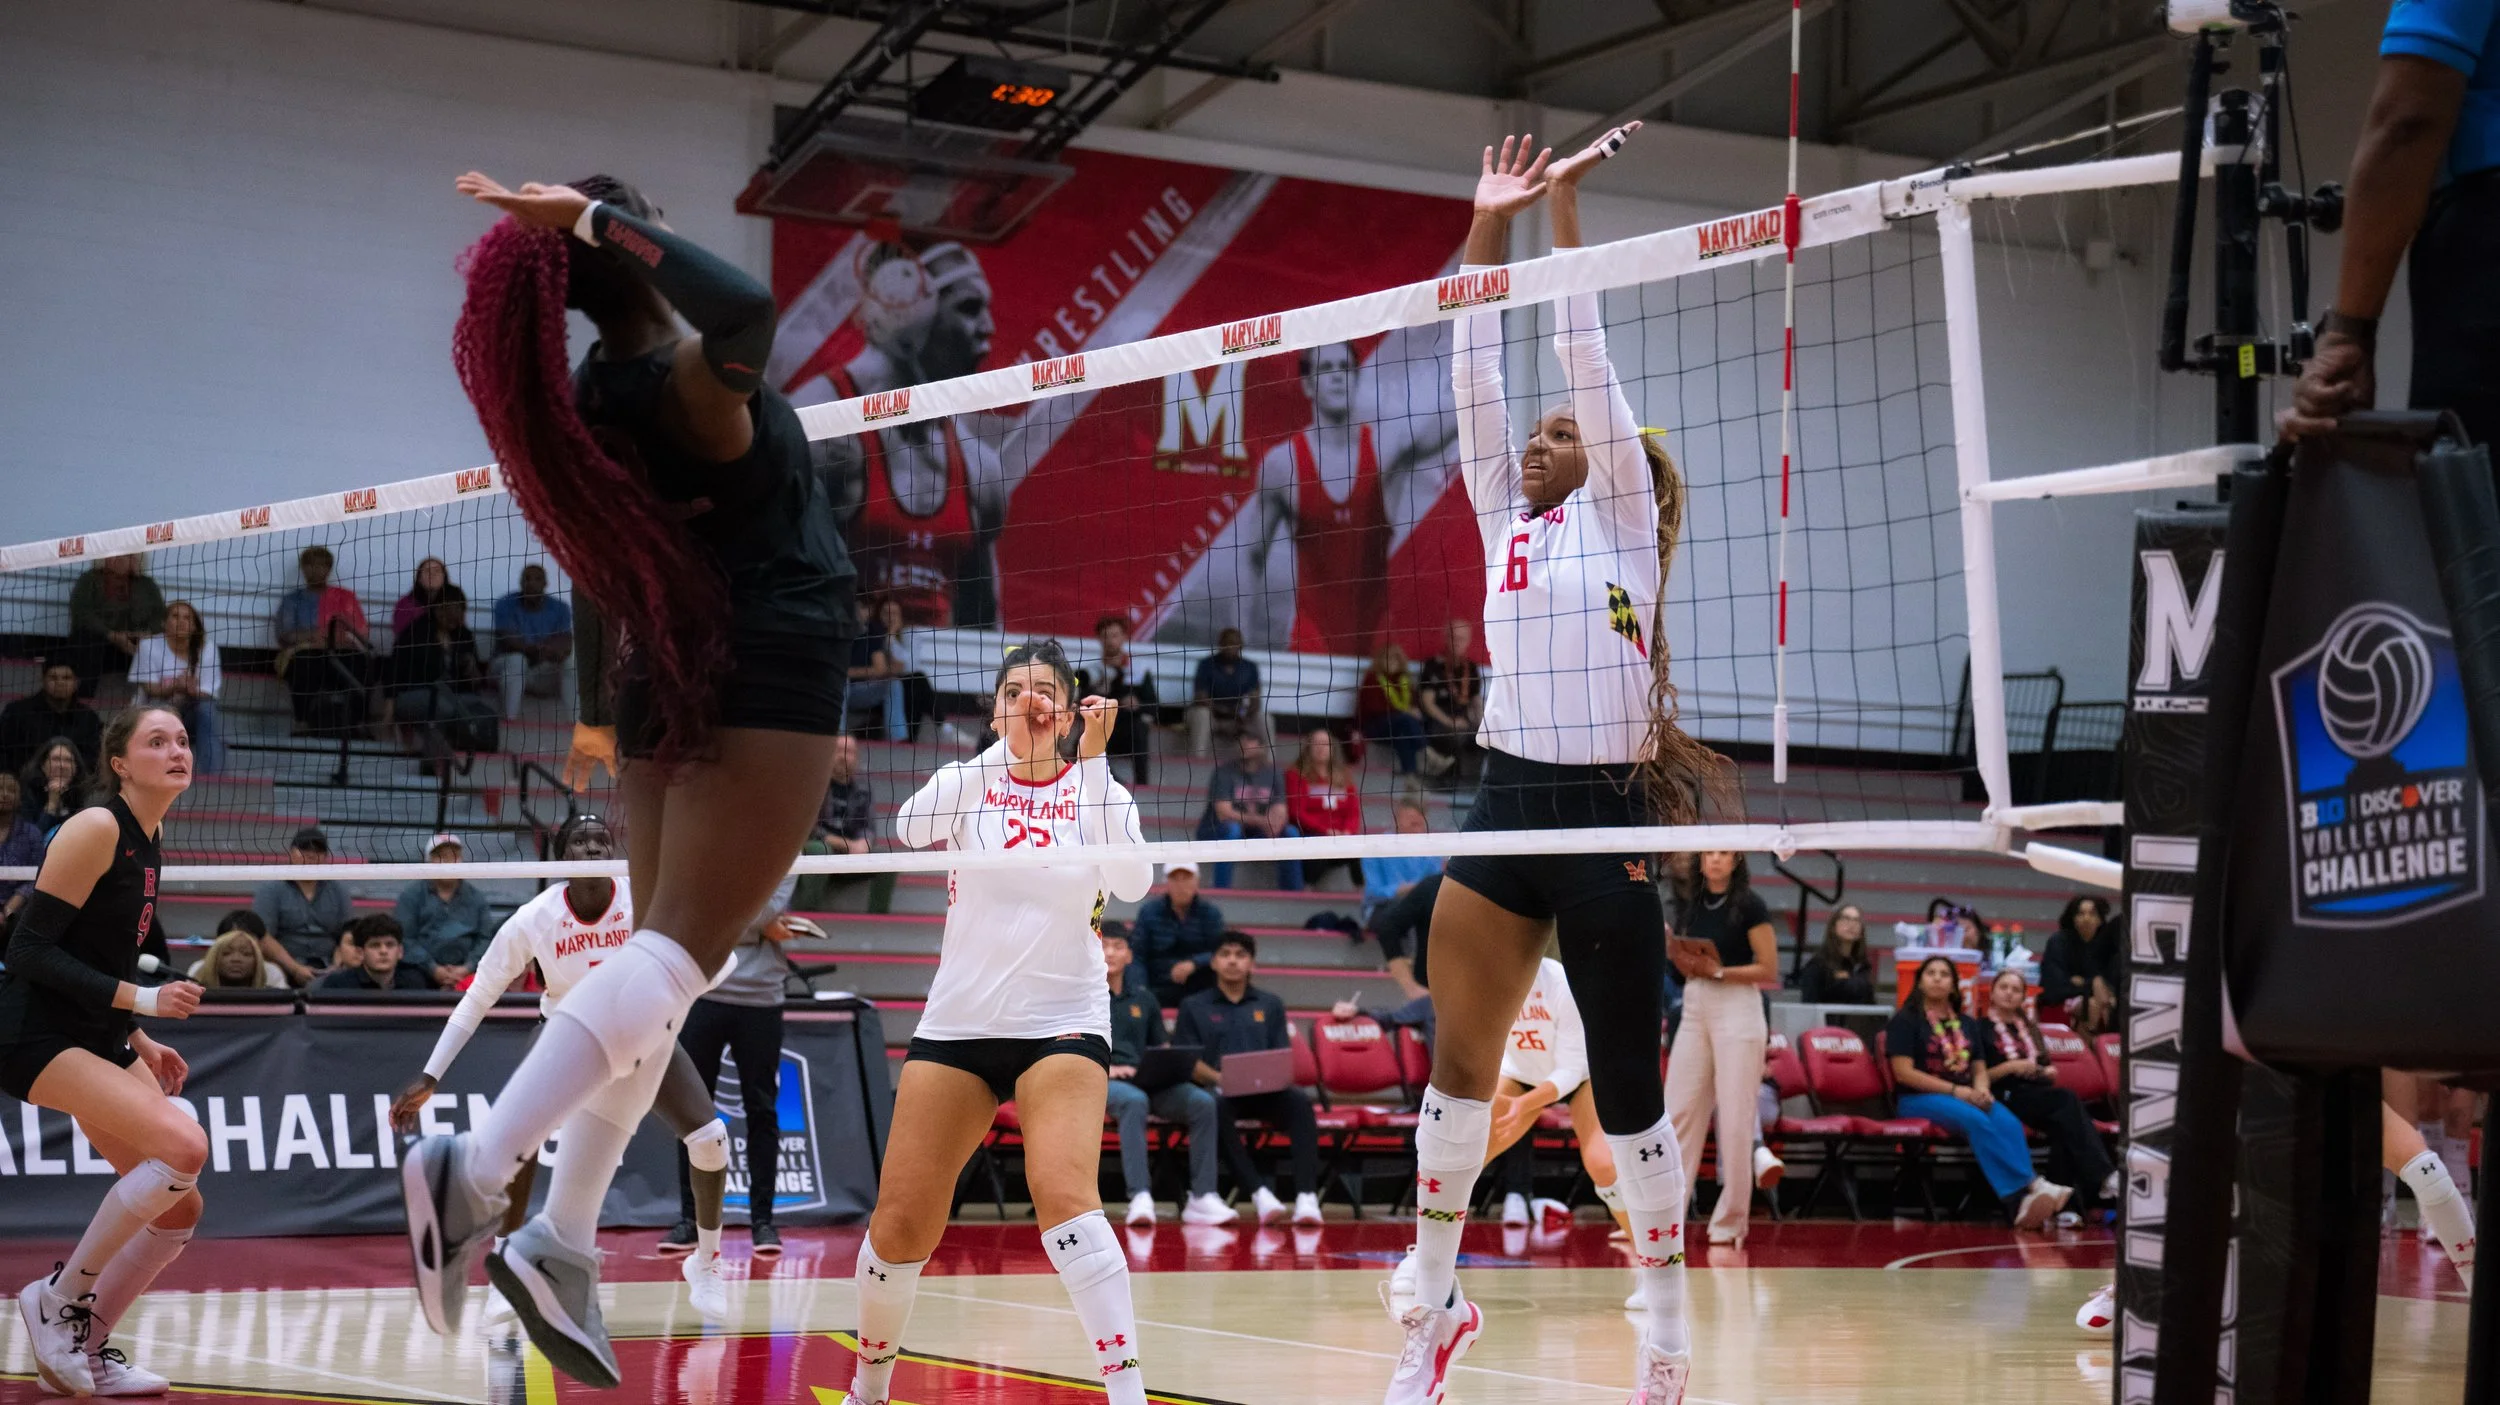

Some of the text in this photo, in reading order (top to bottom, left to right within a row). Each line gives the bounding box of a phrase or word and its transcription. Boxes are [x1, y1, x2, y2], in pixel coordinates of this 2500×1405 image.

[1696, 209, 1782, 254] MARYLAND
[1014, 186, 1194, 365] RESTLING
[1438, 267, 1510, 305] MARYLAND
[1222, 315, 1282, 349] MARYLAND
[1032, 354, 1086, 386] MARYLAND
[863, 388, 911, 417] MARYLAND
[455, 466, 491, 490] MARYLAND
[343, 488, 377, 511] MARYLAND
[2136, 550, 2226, 692] M
[984, 788, 1076, 822] MARYLAND
[2359, 779, 2463, 816] DISCOVER
[2302, 807, 2466, 858] VOLLEYBALL
[143, 867, 156, 897] R
[2303, 837, 2468, 897] CHALLENGE
[136, 902, 154, 947] 9
[1511, 1030, 1547, 1051] 26
[166, 1093, 624, 1172] HALLE
